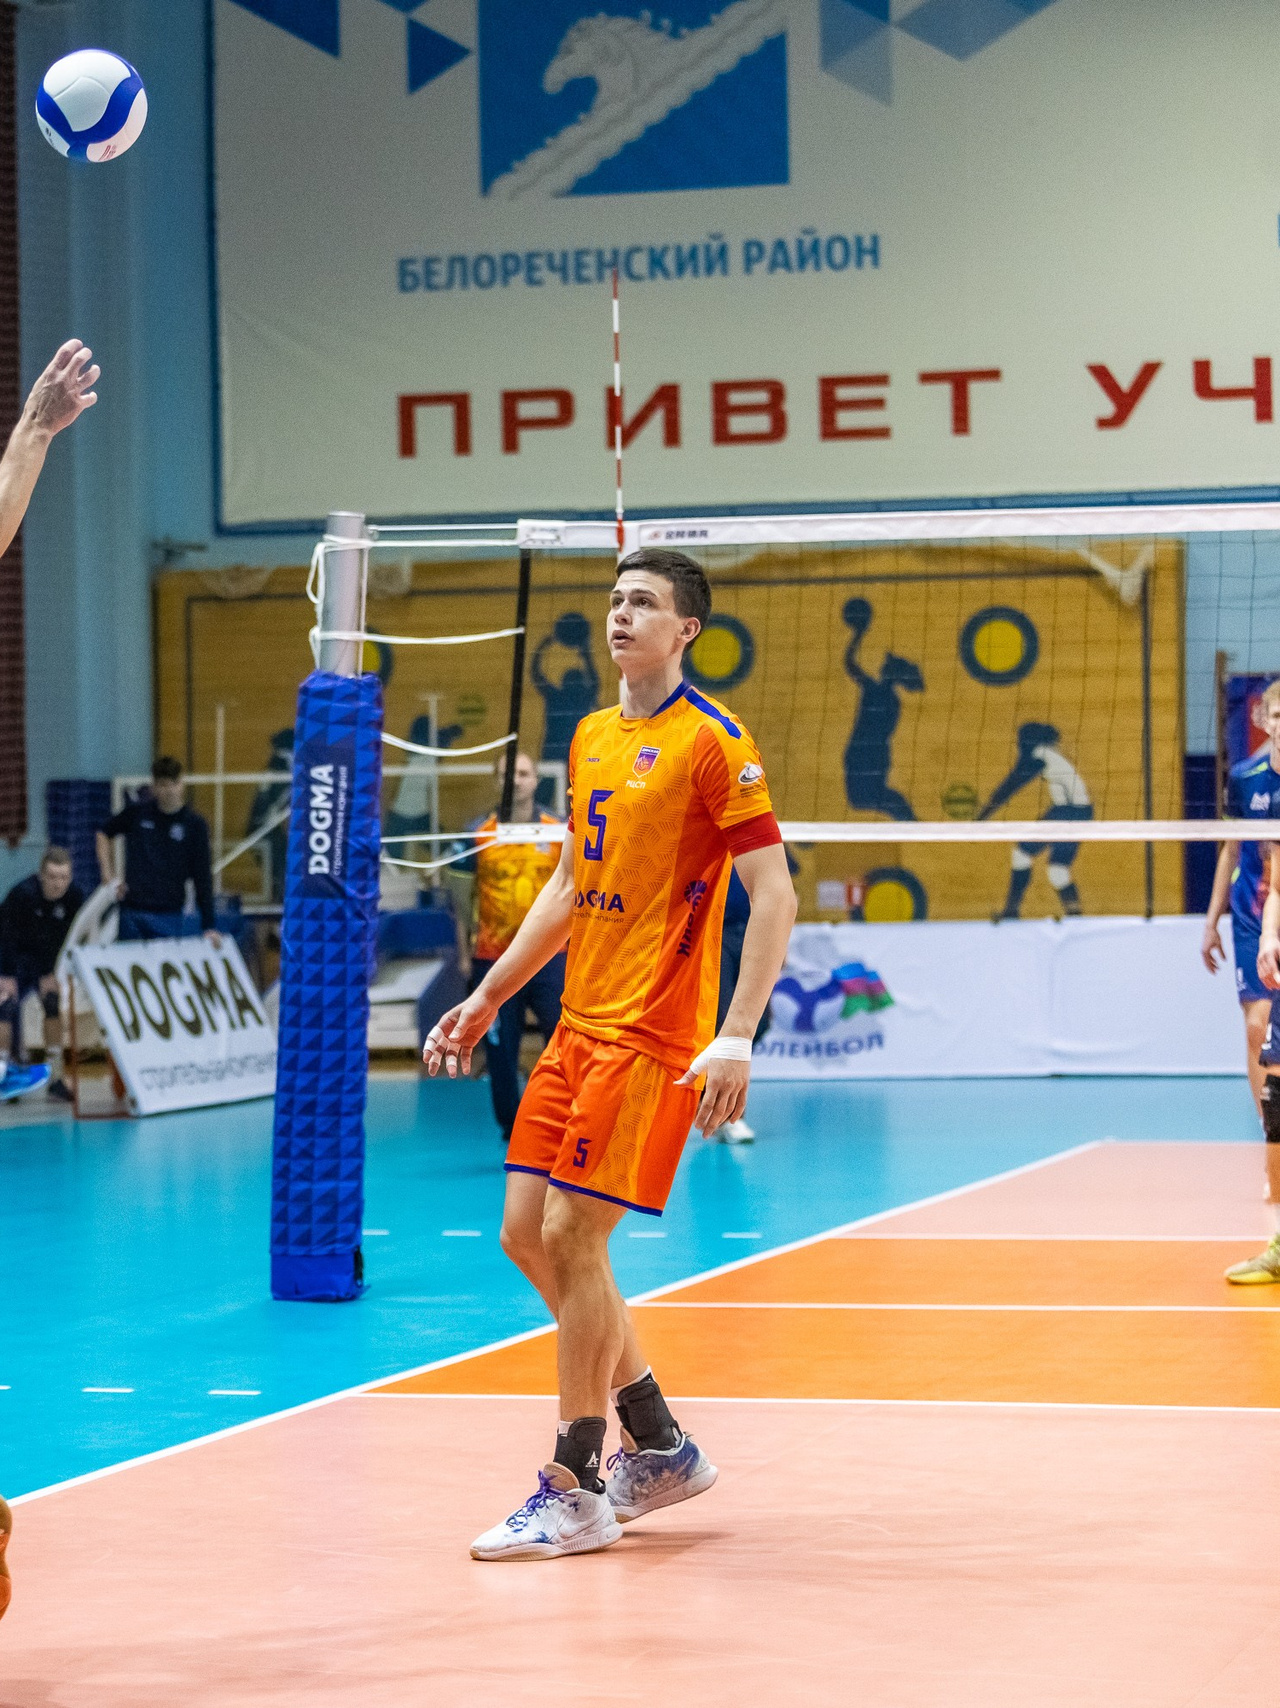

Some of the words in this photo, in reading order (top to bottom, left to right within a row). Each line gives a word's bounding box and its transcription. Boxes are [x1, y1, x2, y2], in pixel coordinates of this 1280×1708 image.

[398, 232, 729, 294] БЕЛОРЕЧЕНСКИЙ
[743, 228, 881, 276] РАЙОН
[398, 369, 1002, 459] ПРИВЕТ
[1086, 357, 1274, 431] УЧ
[308, 763, 334, 876] DOGMA
[625, 780, 646, 789] РЦСП
[584, 789, 615, 861] 5
[94, 957, 264, 1042] DOGMA
[573, 1138, 592, 1168] 5
